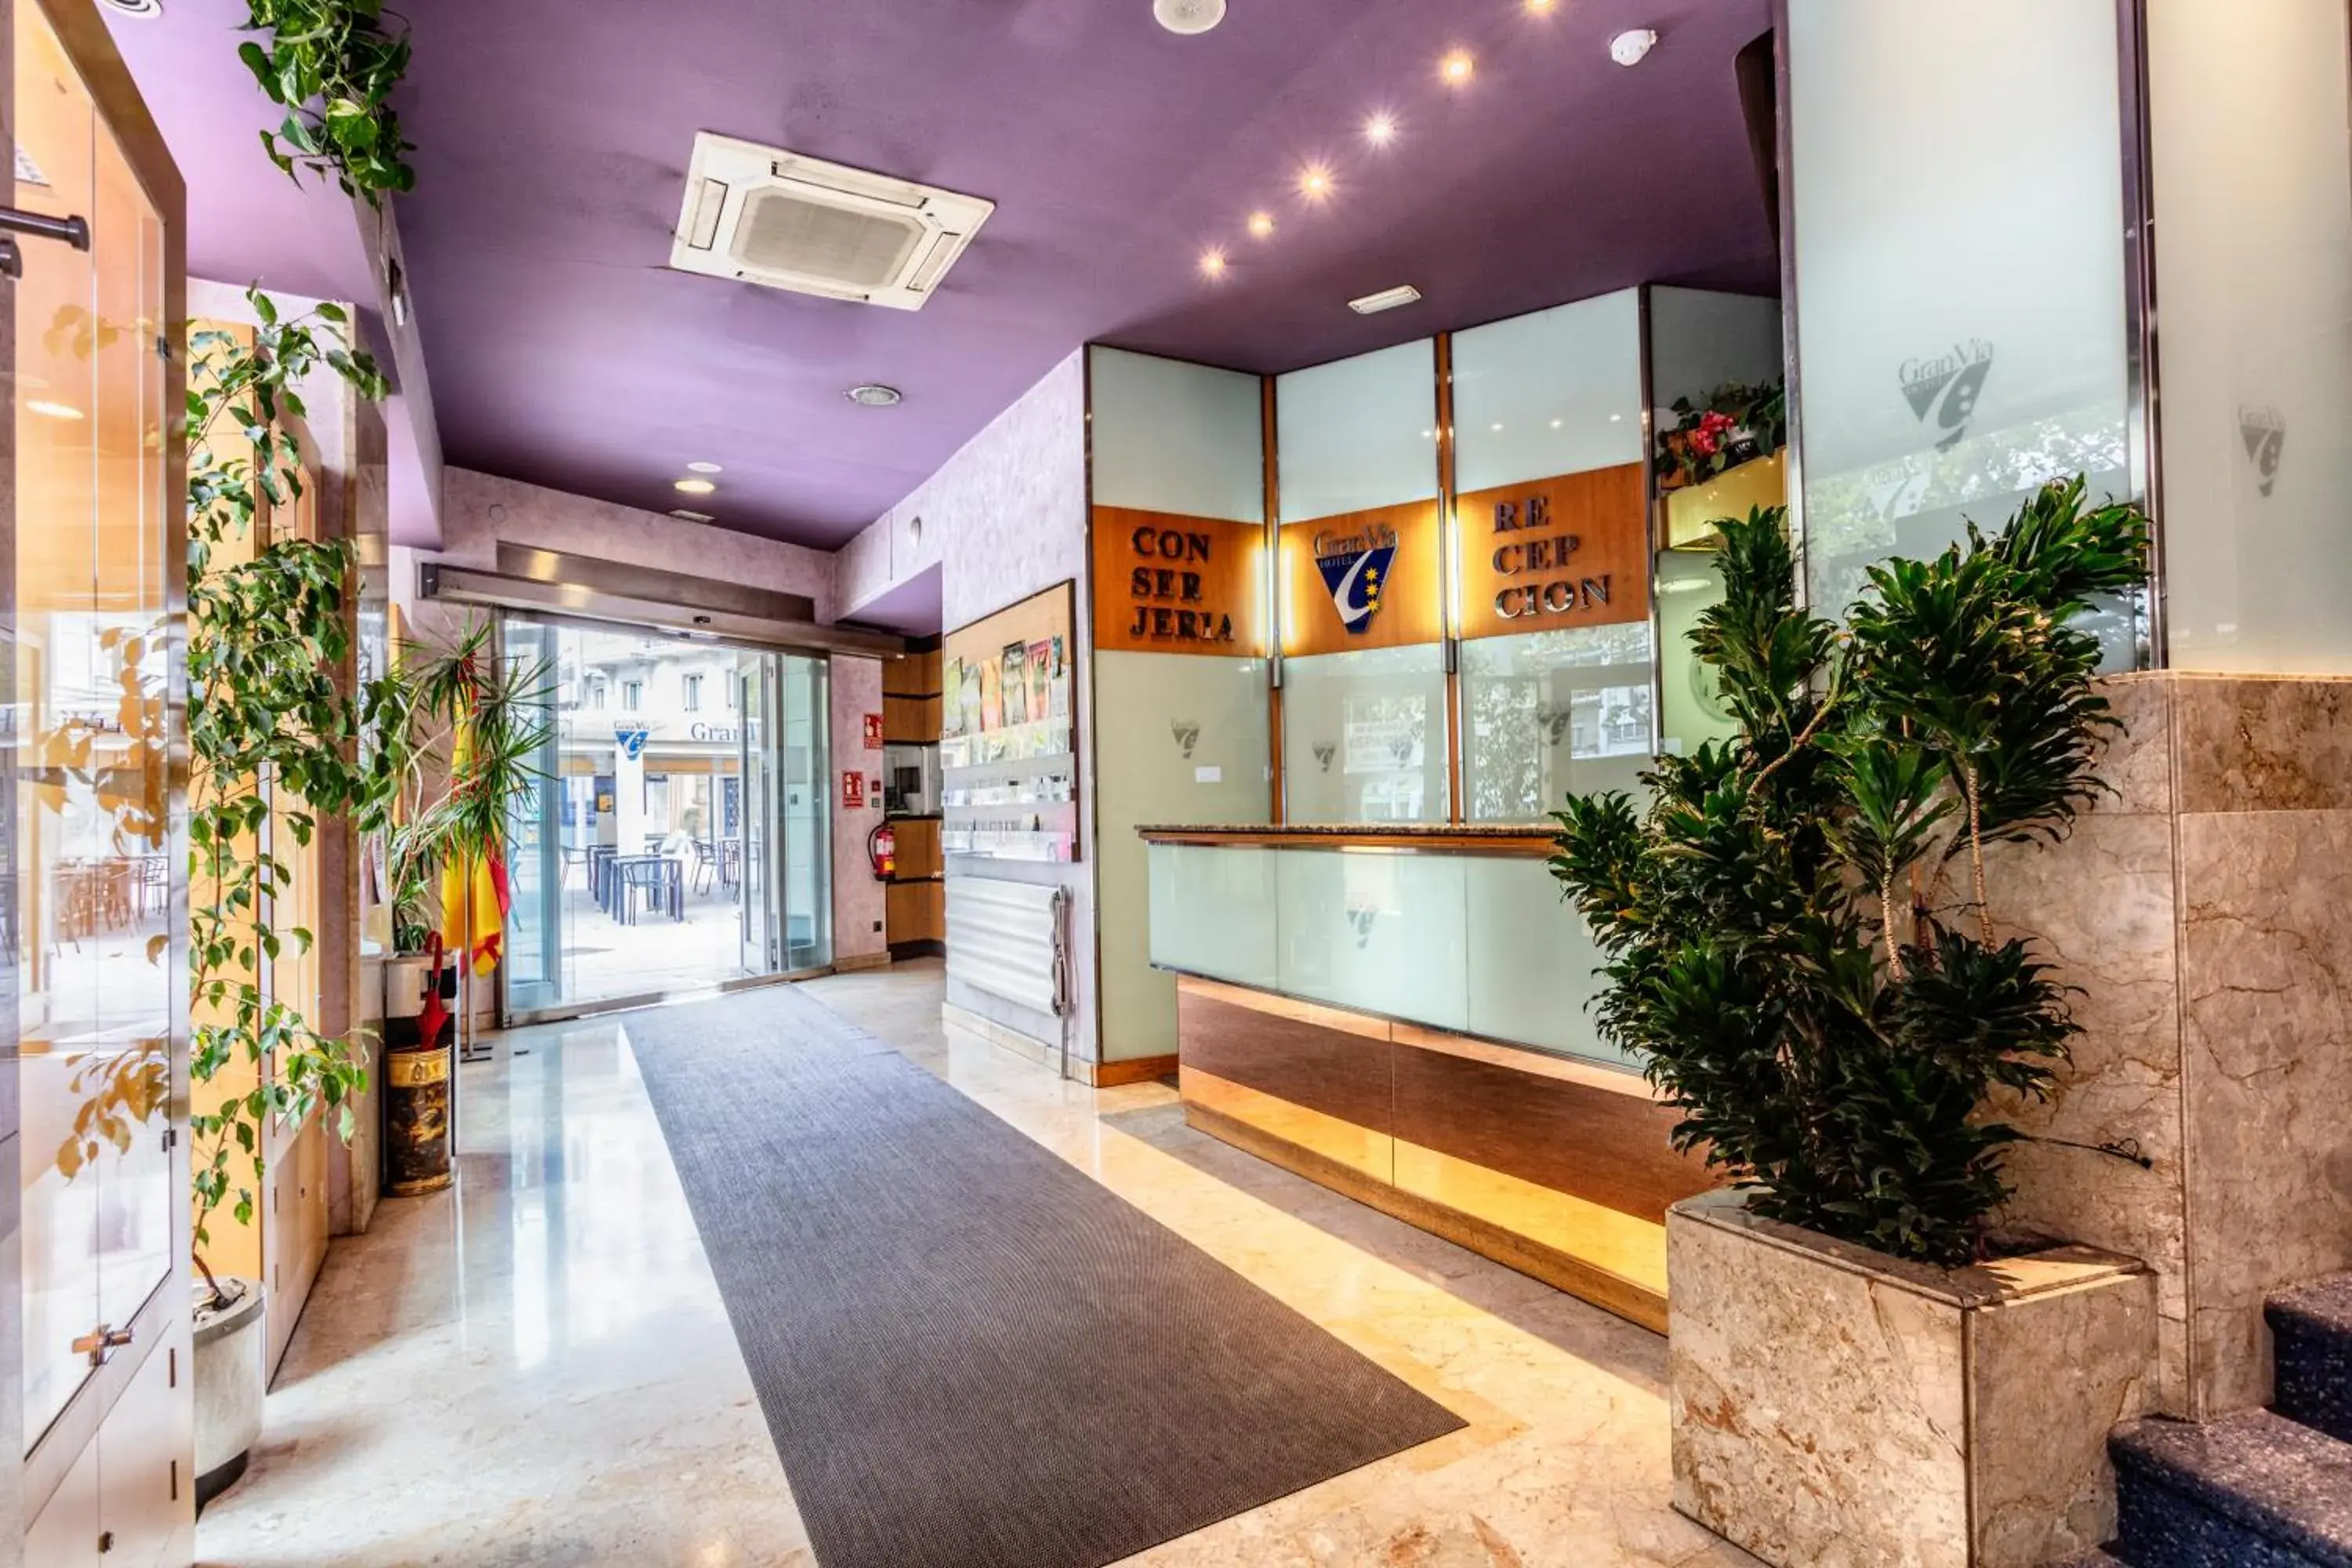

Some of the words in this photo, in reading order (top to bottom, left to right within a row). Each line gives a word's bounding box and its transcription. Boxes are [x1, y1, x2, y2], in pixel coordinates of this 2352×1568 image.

[1493, 495, 1550, 533] RE
[1131, 526, 1211, 563] CON
[1319, 556, 1356, 568] HOTEL
[1493, 534, 1581, 575] CEP
[1131, 566, 1203, 601] SER
[1494, 574, 1611, 619] CION
[1129, 606, 1236, 642] JERIA
